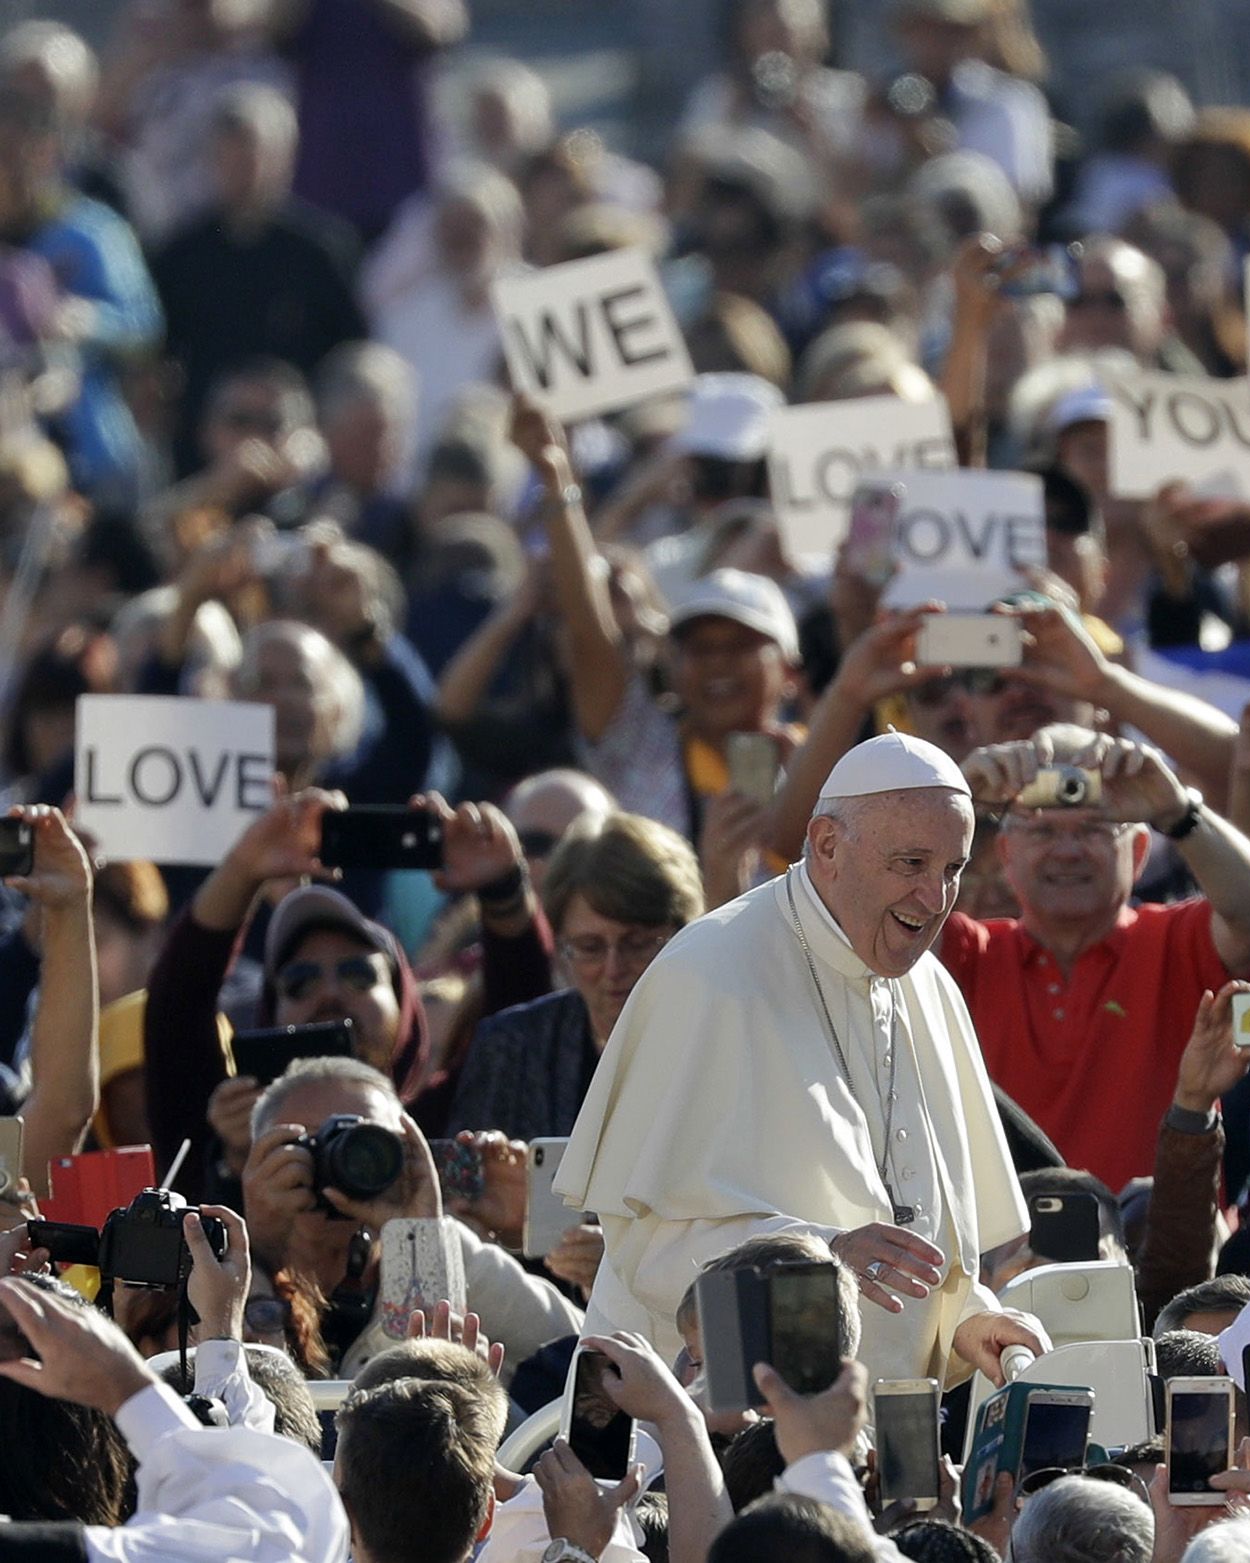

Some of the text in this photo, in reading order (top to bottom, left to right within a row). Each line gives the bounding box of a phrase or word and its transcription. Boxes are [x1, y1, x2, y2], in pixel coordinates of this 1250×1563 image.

[507, 282, 670, 391] WE
[897, 507, 1047, 569] OVE
[85, 745, 272, 810] LOVE
